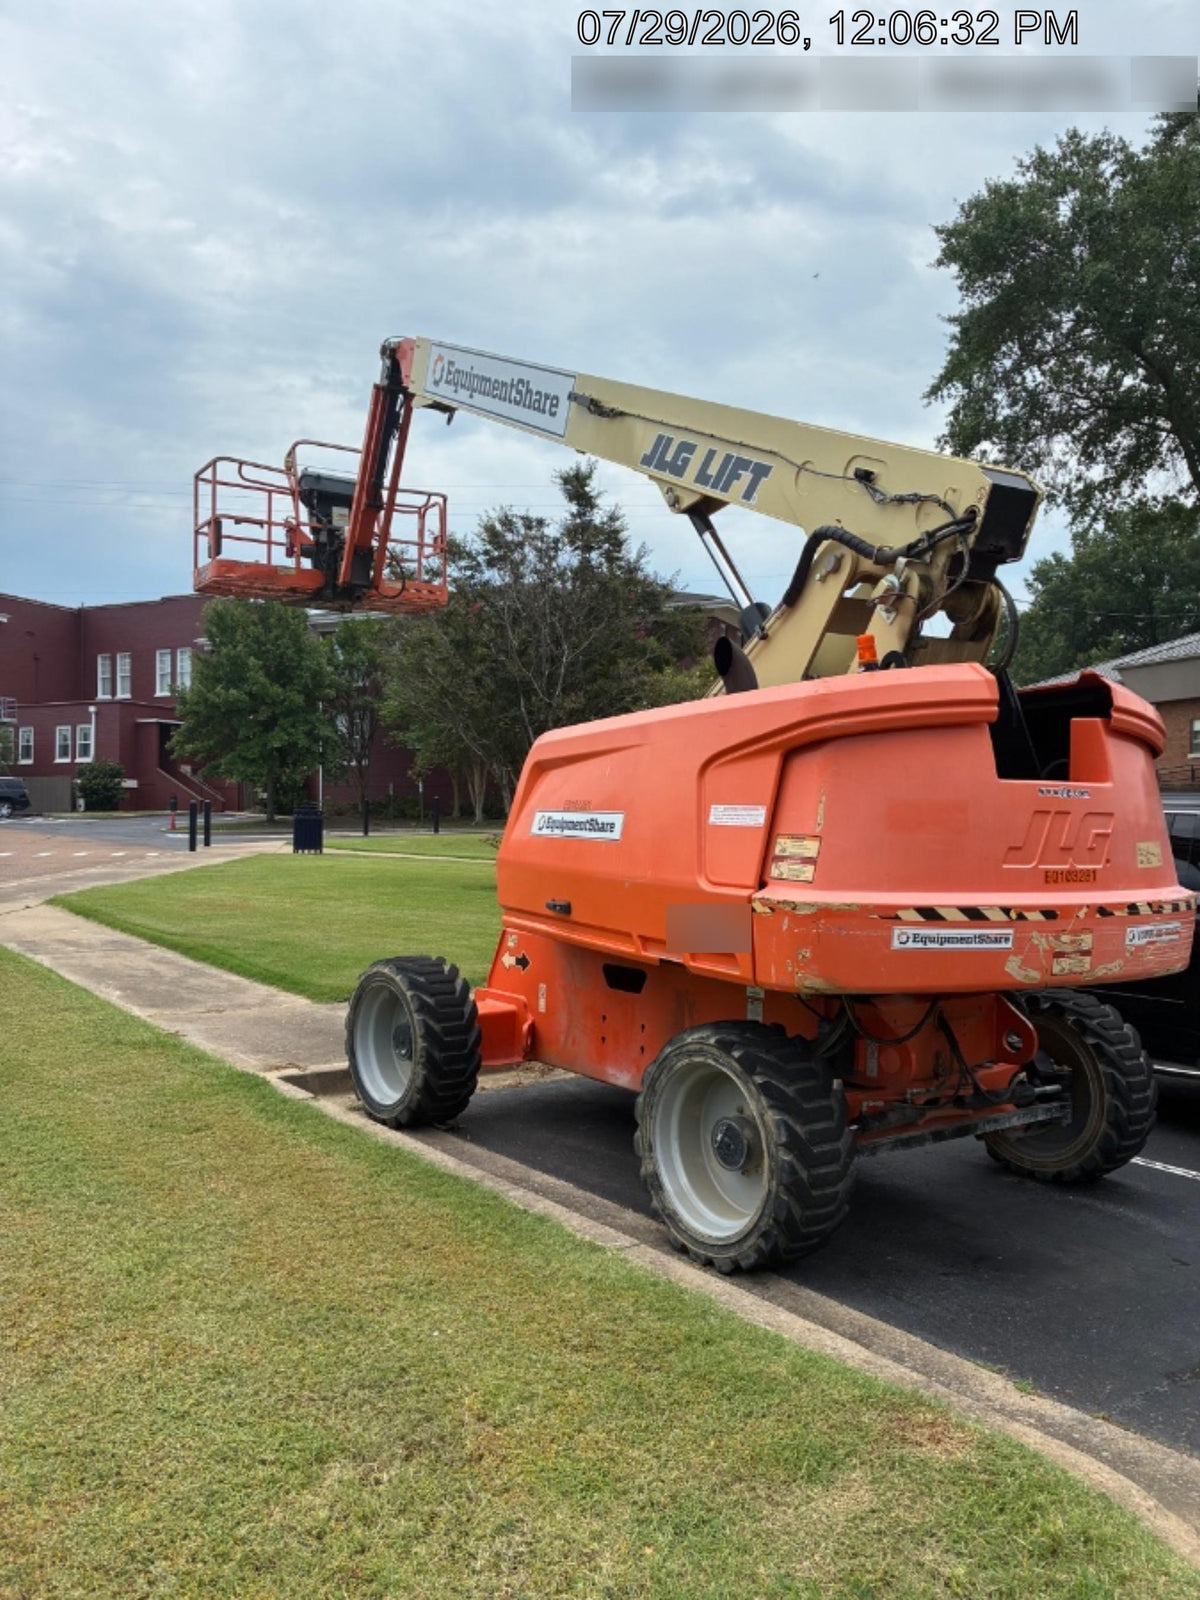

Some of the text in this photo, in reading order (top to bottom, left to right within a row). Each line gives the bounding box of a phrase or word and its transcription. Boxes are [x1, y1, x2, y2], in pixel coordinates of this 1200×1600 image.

[445, 360, 560, 417] EquipmentShare
[640, 433, 774, 502] JLG LIFT
[546, 816, 616, 833] EquipmentShare
[1002, 810, 1115, 868] JLG
[911, 932, 1011, 946] EquipmentShare
